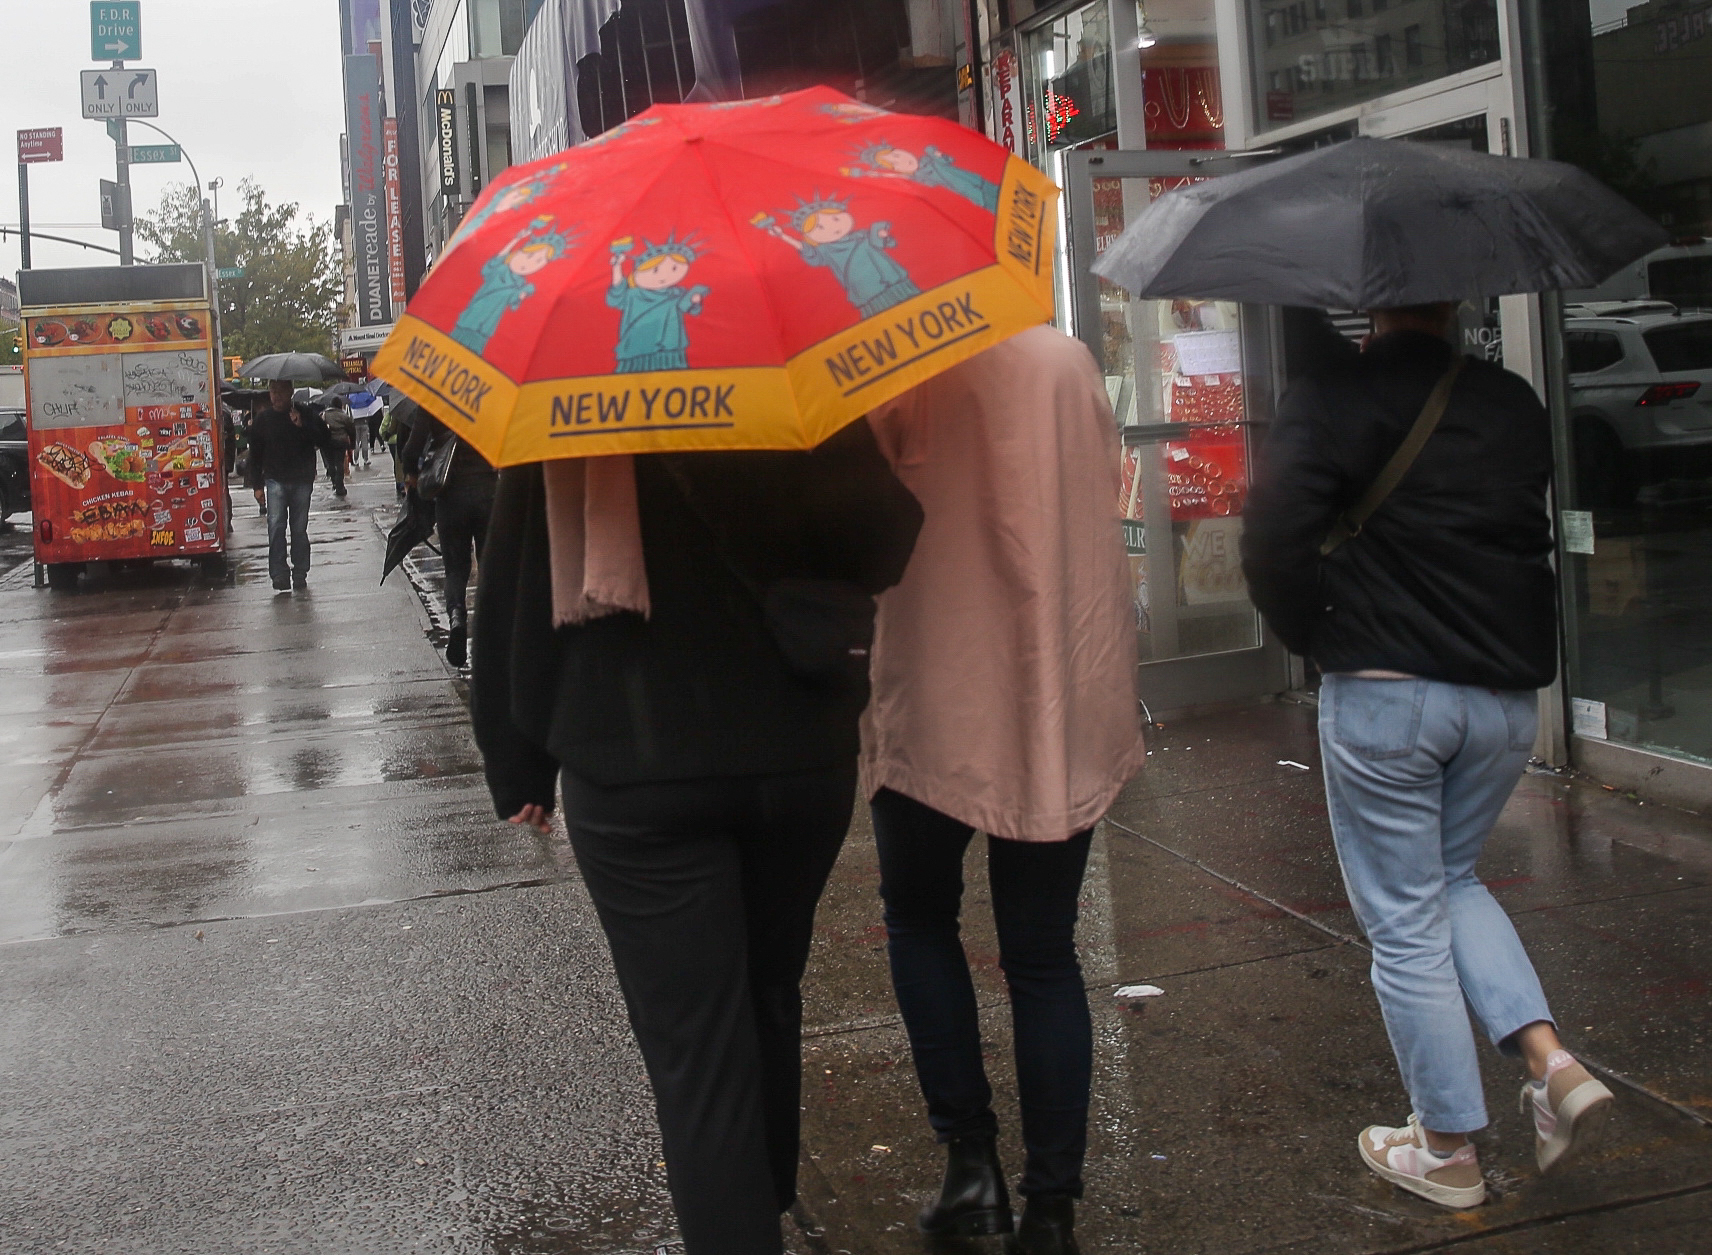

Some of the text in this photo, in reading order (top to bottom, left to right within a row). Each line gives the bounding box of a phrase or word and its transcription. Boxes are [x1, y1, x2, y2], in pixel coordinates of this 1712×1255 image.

[98, 24, 134, 36] Drive
[88, 104, 115, 114] ONLY
[126, 103, 152, 113] ONLY
[29, 131, 56, 140] STANDING
[21, 140, 43, 149] Anytime
[440, 107, 455, 186] McDonald's
[133, 148, 165, 161] Essex
[386, 139, 399, 181] FOR
[367, 193, 377, 206] by
[390, 187, 402, 257] LEASE
[1008, 180, 1038, 269] NEW YORK
[825, 291, 984, 387] NEW YORK
[403, 336, 492, 414] NEW YORK
[551, 384, 736, 427] NEW YORK
[82, 490, 134, 507] CHICKEN KEBAB
